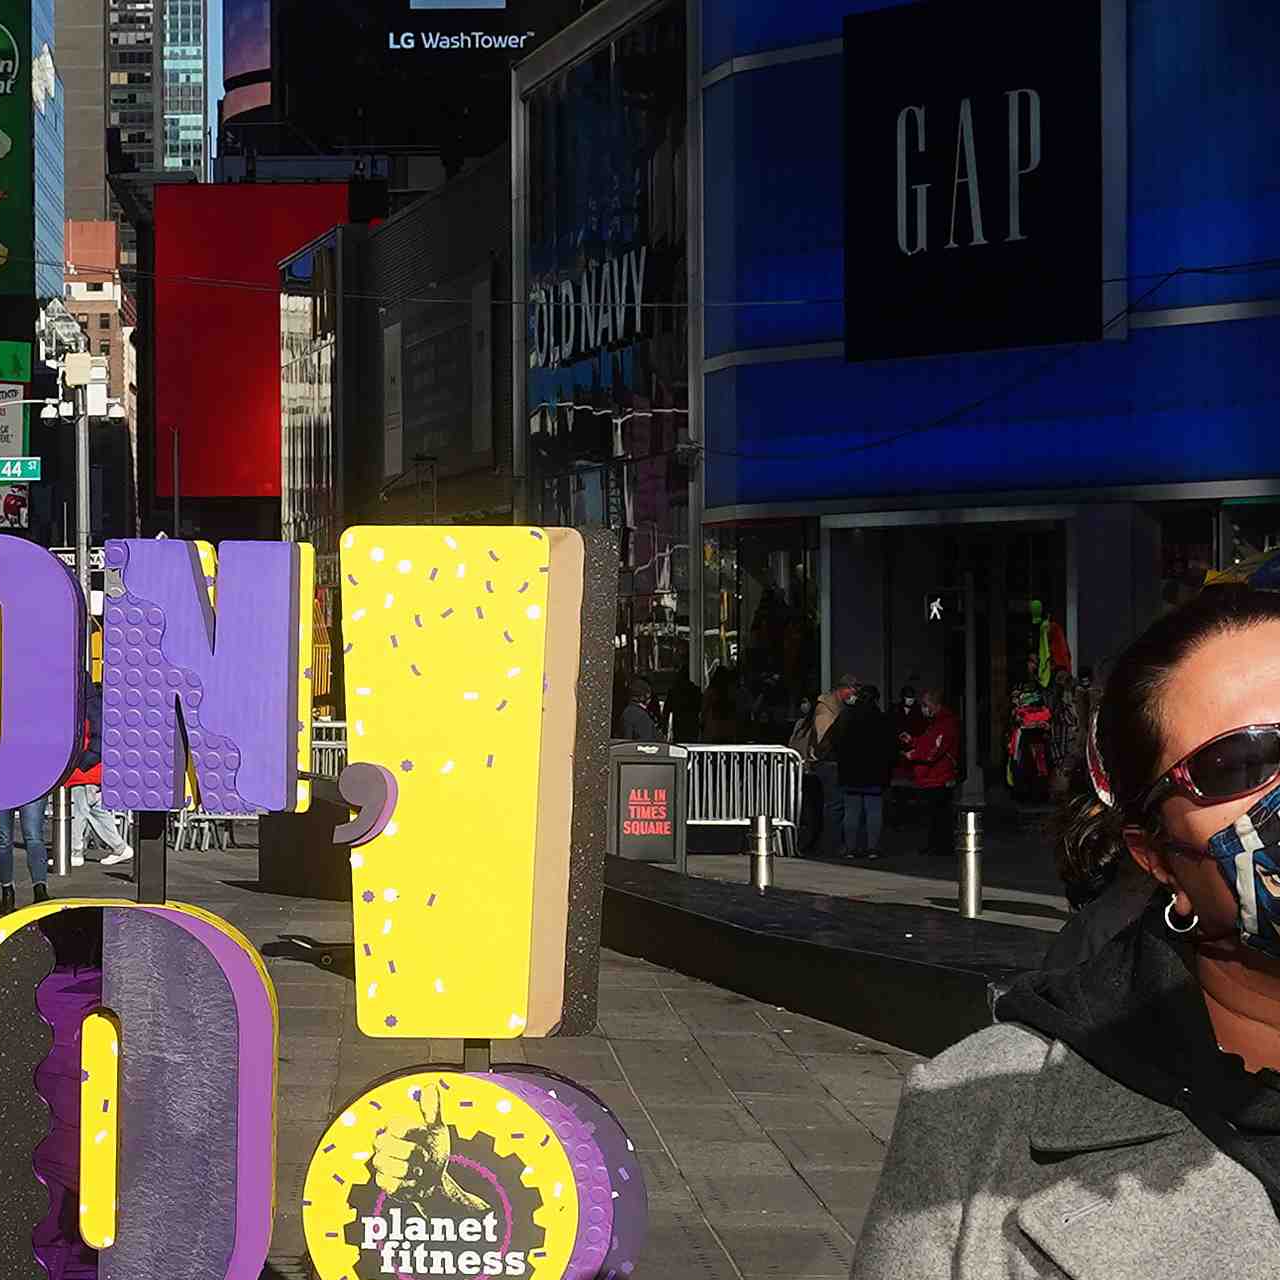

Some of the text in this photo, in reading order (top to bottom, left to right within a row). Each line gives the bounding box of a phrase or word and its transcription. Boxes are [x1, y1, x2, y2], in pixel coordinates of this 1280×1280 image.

[389, 32, 415, 49] LG
[896, 88, 1041, 256] GAP
[534, 245, 647, 367] OLD NAVY
[2, 461, 22, 477] 44
[628, 788, 667, 801] ALL IN
[628, 805, 667, 819] TIMES
[623, 820, 672, 835] SQUARE
[361, 1208, 498, 1249] planet
[379, 1239, 527, 1275] fitness
